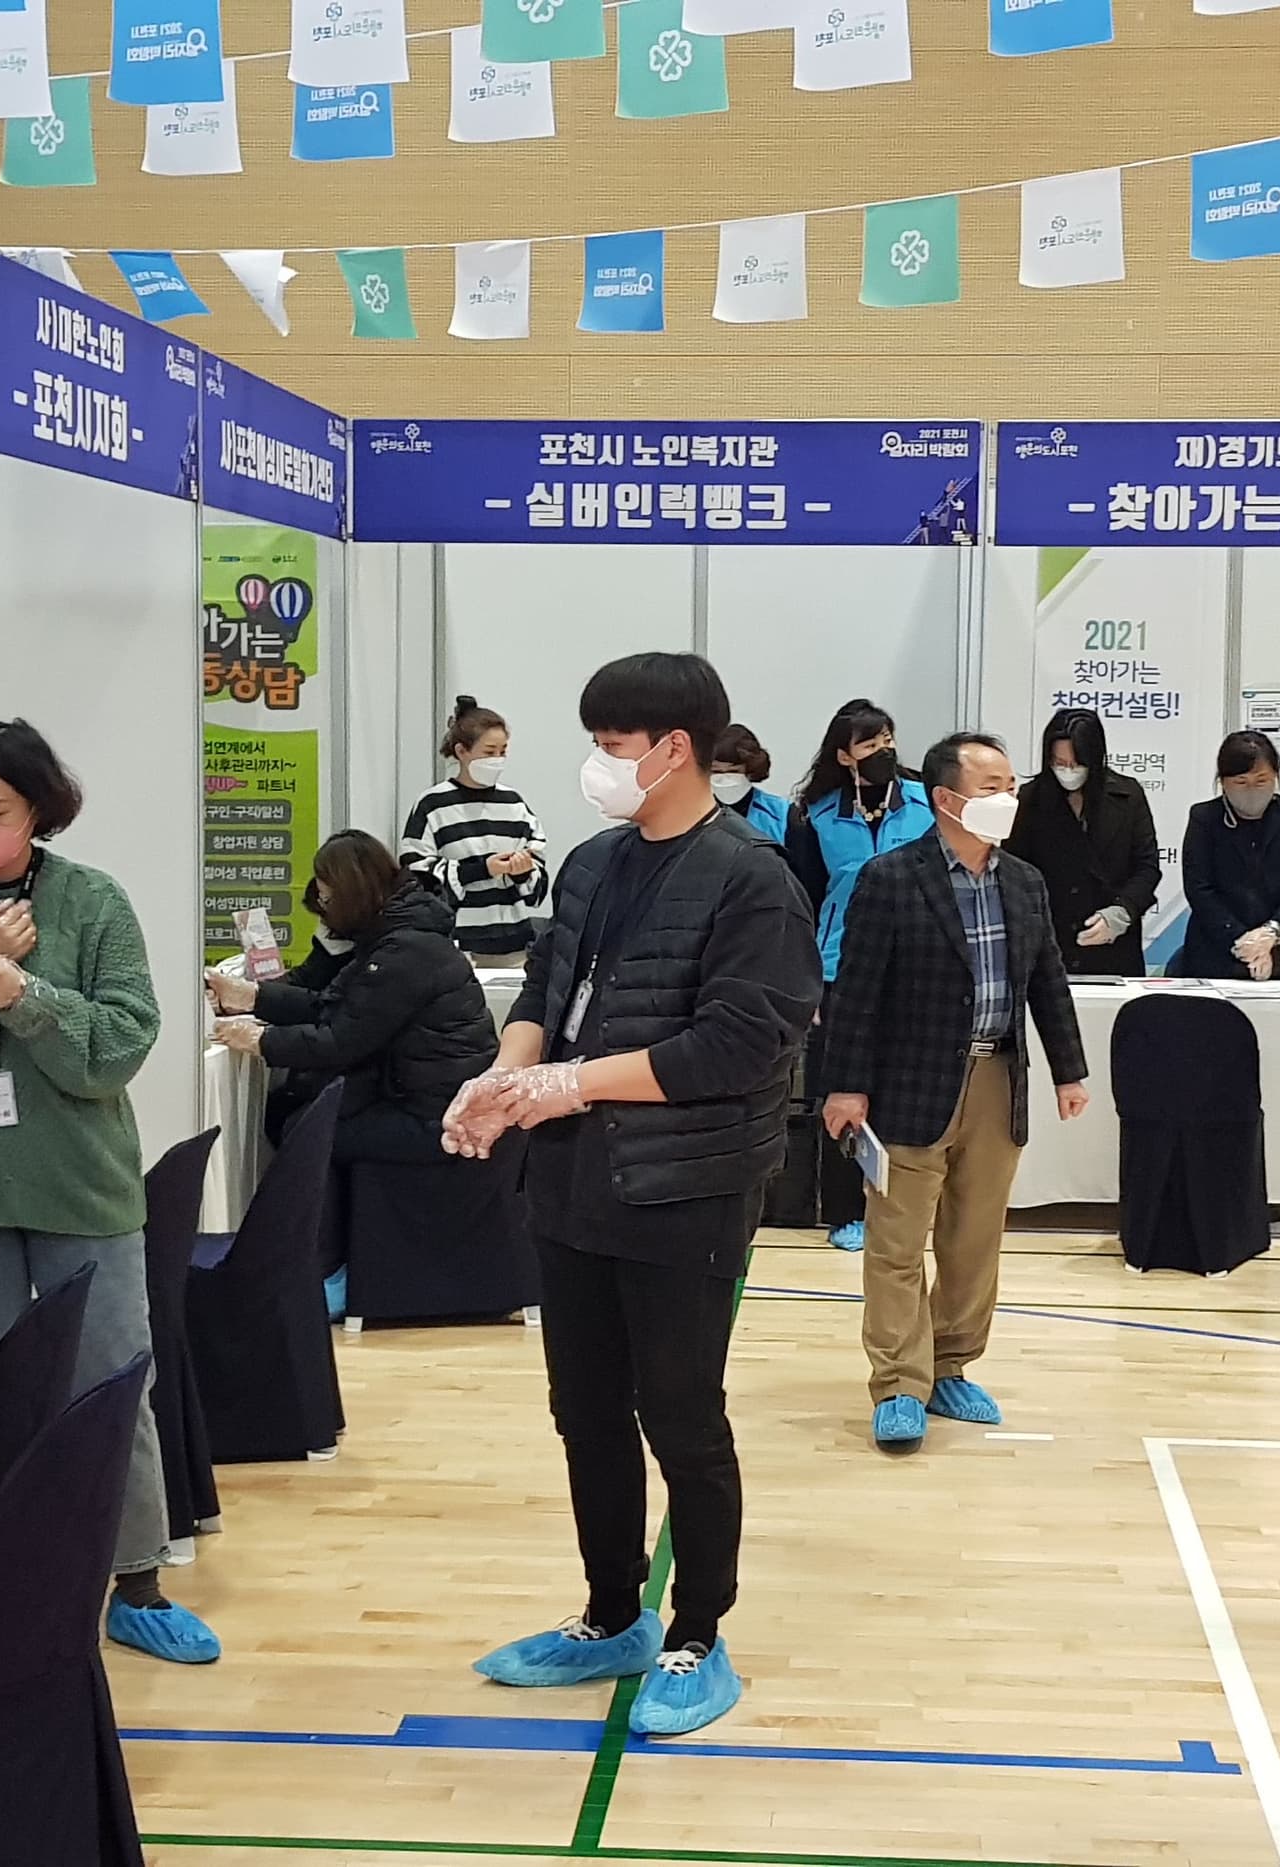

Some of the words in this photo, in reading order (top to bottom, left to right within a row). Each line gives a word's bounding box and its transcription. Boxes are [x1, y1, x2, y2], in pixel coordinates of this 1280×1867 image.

[37, 297, 124, 374] 사)대한노인회
[32, 369, 127, 462] 포천시지회
[540, 434, 624, 466] 포천시
[634, 433, 779, 468] 노인복지관
[526, 482, 787, 530] 실버인력뱅크
[1085, 620, 1146, 650] 2021
[1074, 660, 1161, 684] 찾아가는
[256, 779, 296, 792] 파트너
[261, 837, 284, 849] 상담
